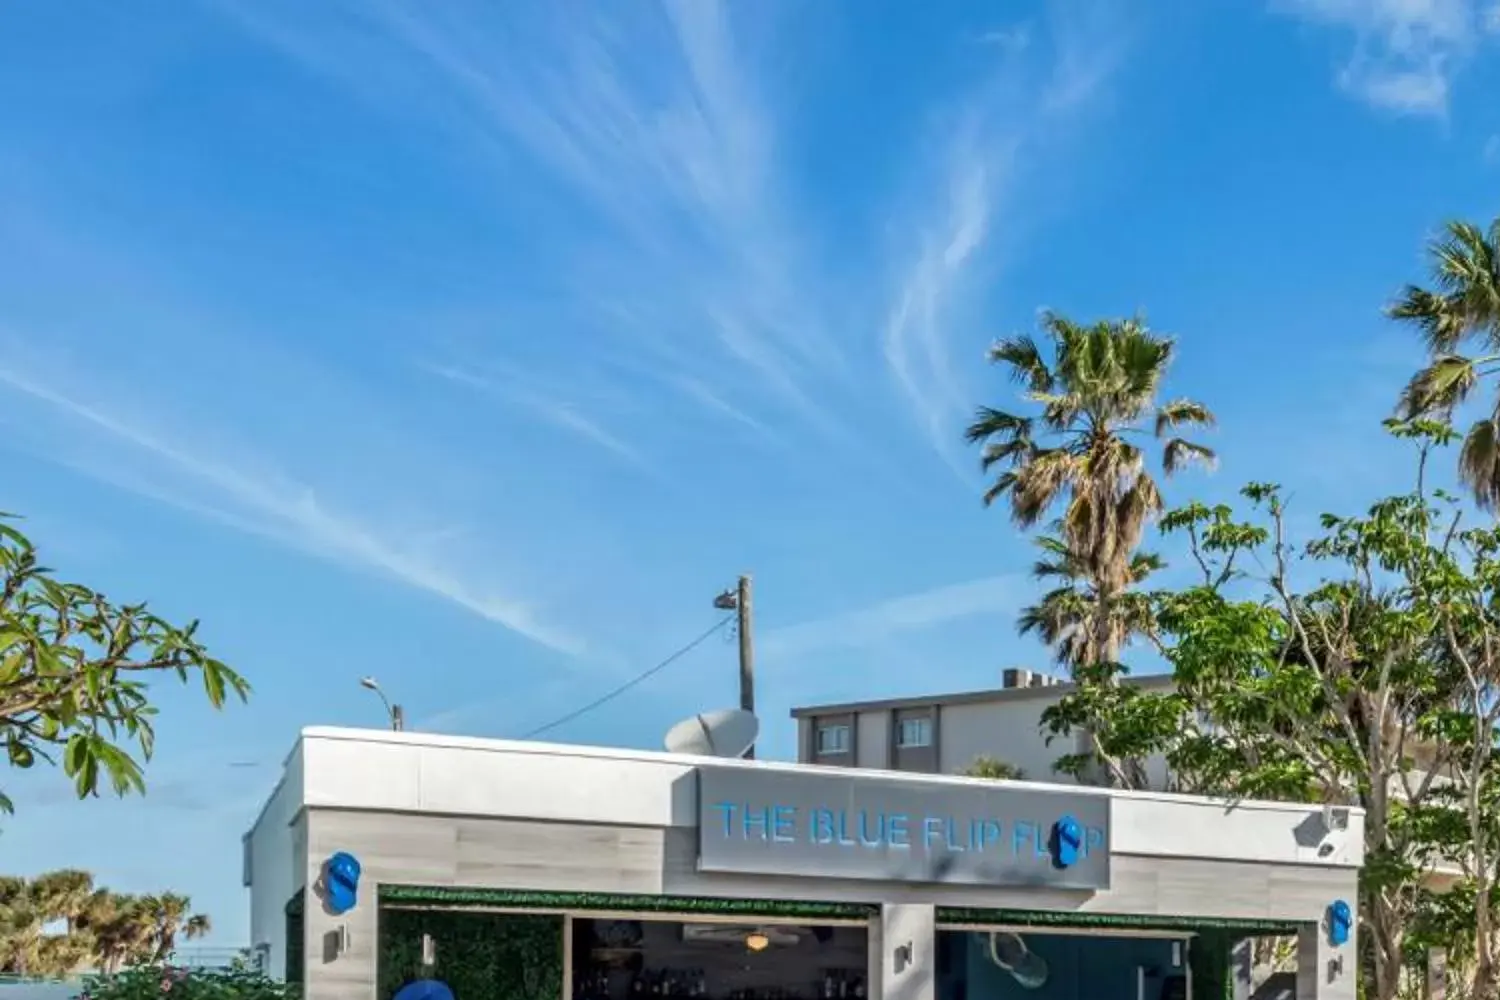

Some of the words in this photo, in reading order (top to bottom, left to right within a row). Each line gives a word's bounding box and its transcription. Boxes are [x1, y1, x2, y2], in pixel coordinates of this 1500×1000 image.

[712, 801, 795, 842] THE
[810, 805, 911, 848] BLUE
[924, 817, 1001, 852] FLIP
[1013, 816, 1104, 863] FLP
